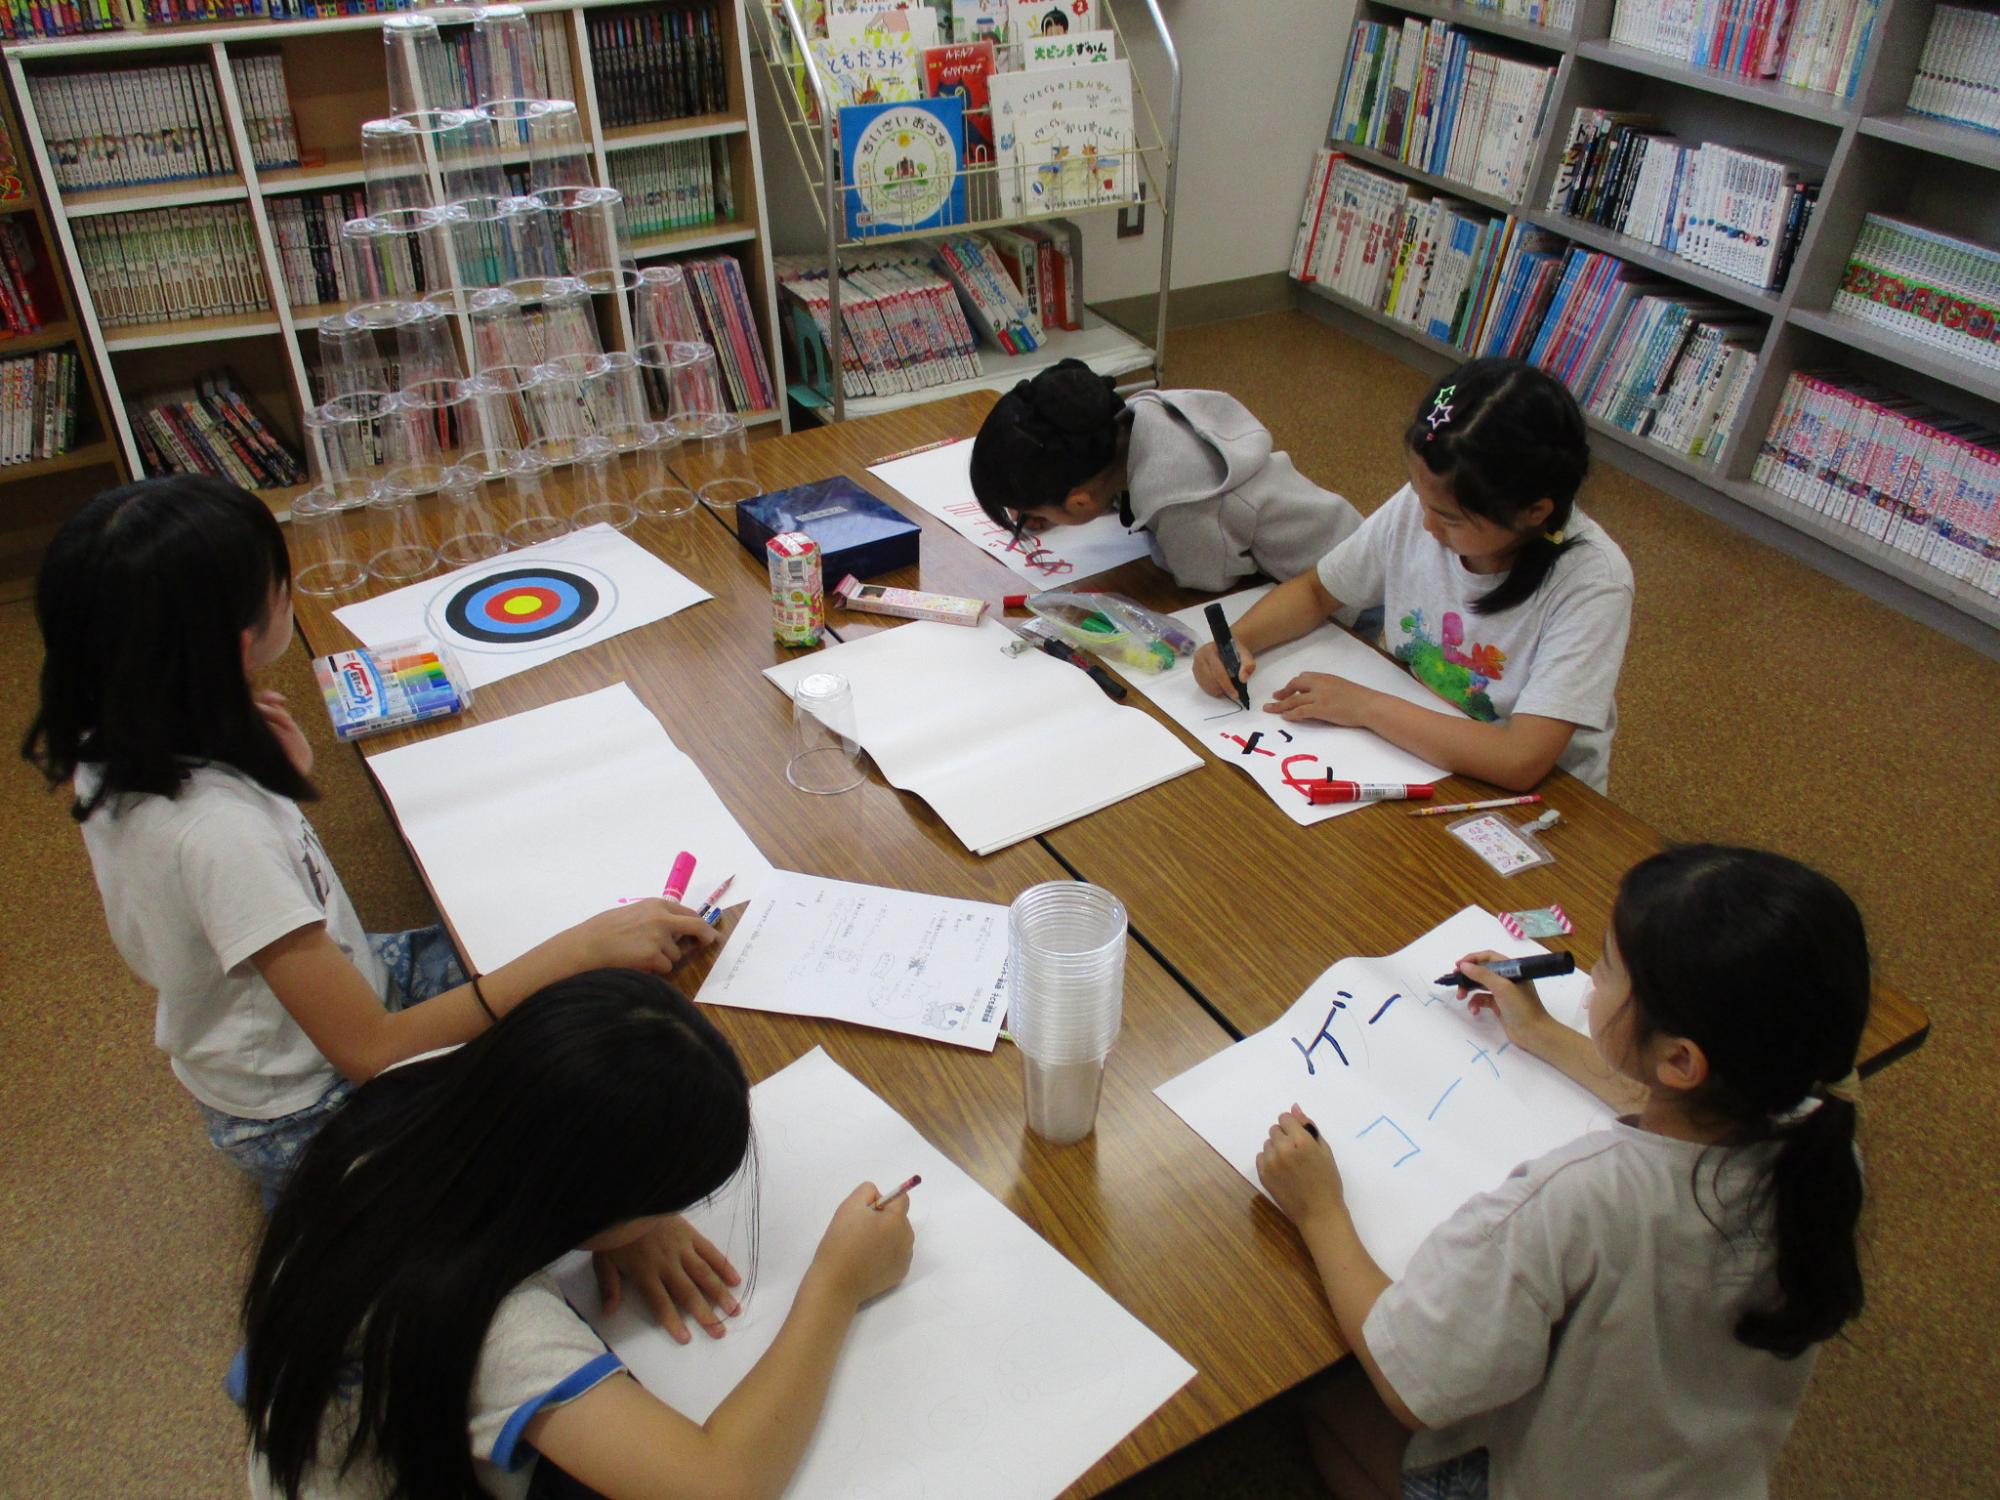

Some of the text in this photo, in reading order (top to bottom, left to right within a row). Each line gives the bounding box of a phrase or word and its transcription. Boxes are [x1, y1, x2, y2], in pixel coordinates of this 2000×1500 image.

[827, 49, 903, 75] ともだちや
[1034, 41, 1107, 61] 大ピンチずかん
[861, 115, 948, 155] ちいさいおうち
